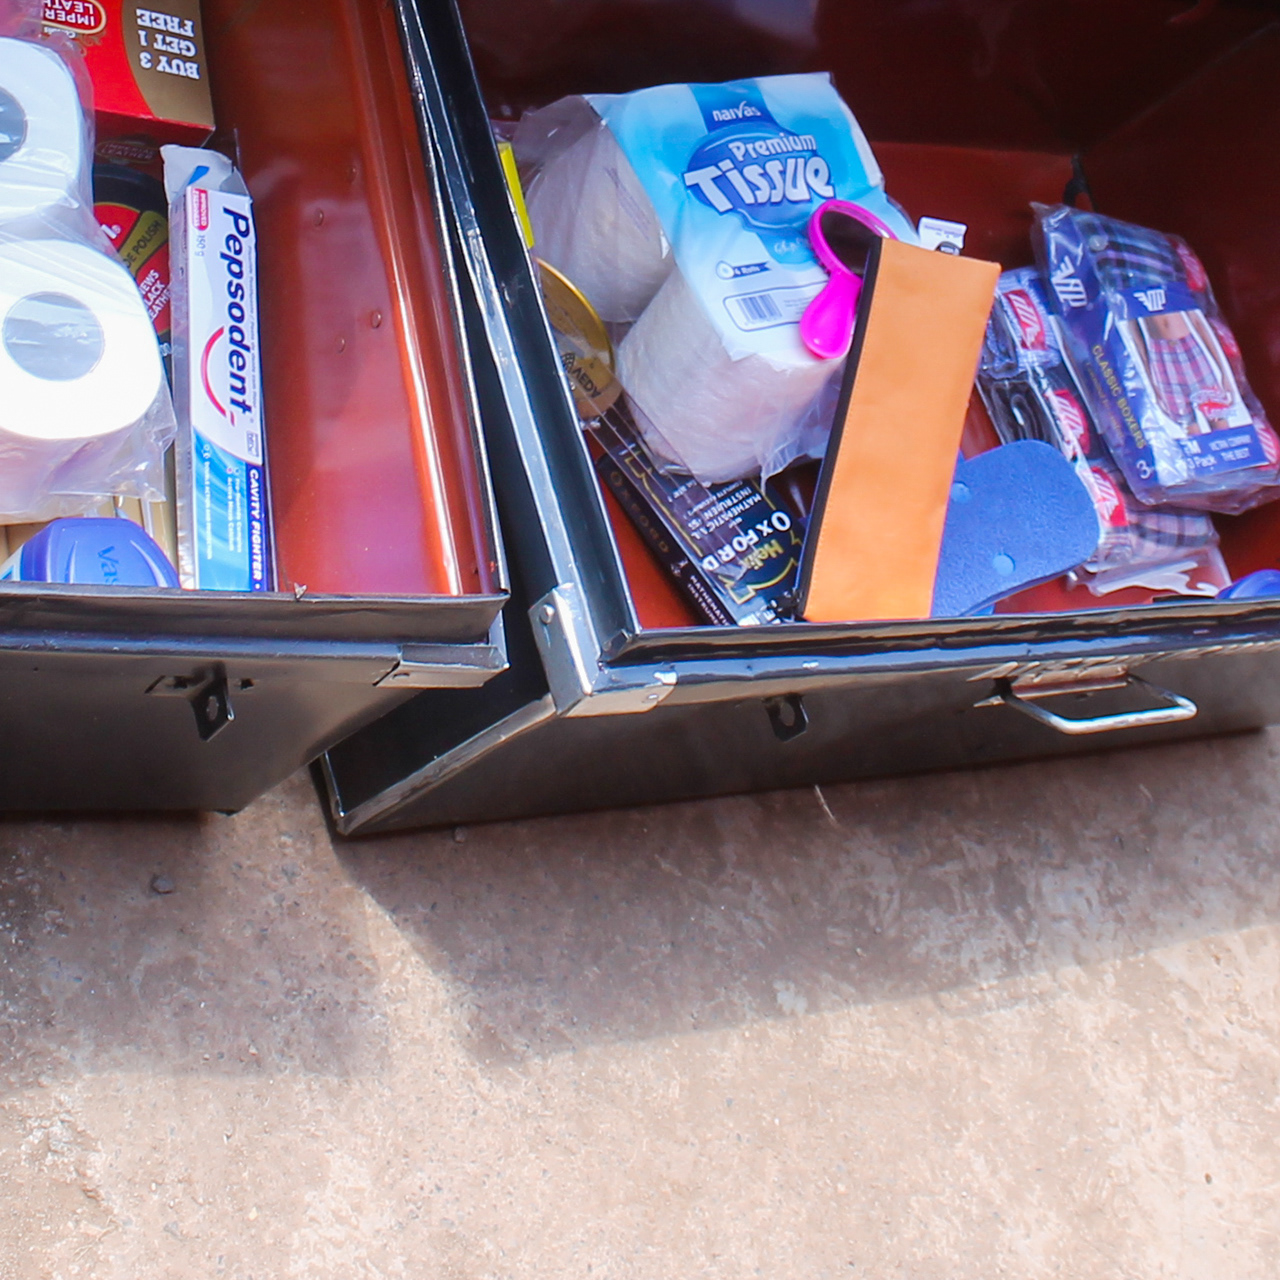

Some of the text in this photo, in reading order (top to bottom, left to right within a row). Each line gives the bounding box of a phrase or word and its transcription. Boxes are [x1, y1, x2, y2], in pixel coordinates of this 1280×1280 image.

[136, 7, 195, 37] FREE
[138, 30, 197, 58] GET 1
[139, 52, 200, 80] BUY 3
[712, 100, 762, 122] naivas
[729, 132, 817, 162] Premium
[682, 155, 836, 214] Tissue
[134, 220, 162, 256] POLISH
[220, 206, 252, 416] Pepsodent
[1091, 344, 1121, 396] CLASSIC
[1116, 396, 1146, 450] BOXERS
[250, 469, 260, 519] CAVITY
[251, 521, 263, 580] FIGHTER
[702, 510, 791, 572] OXFORD
